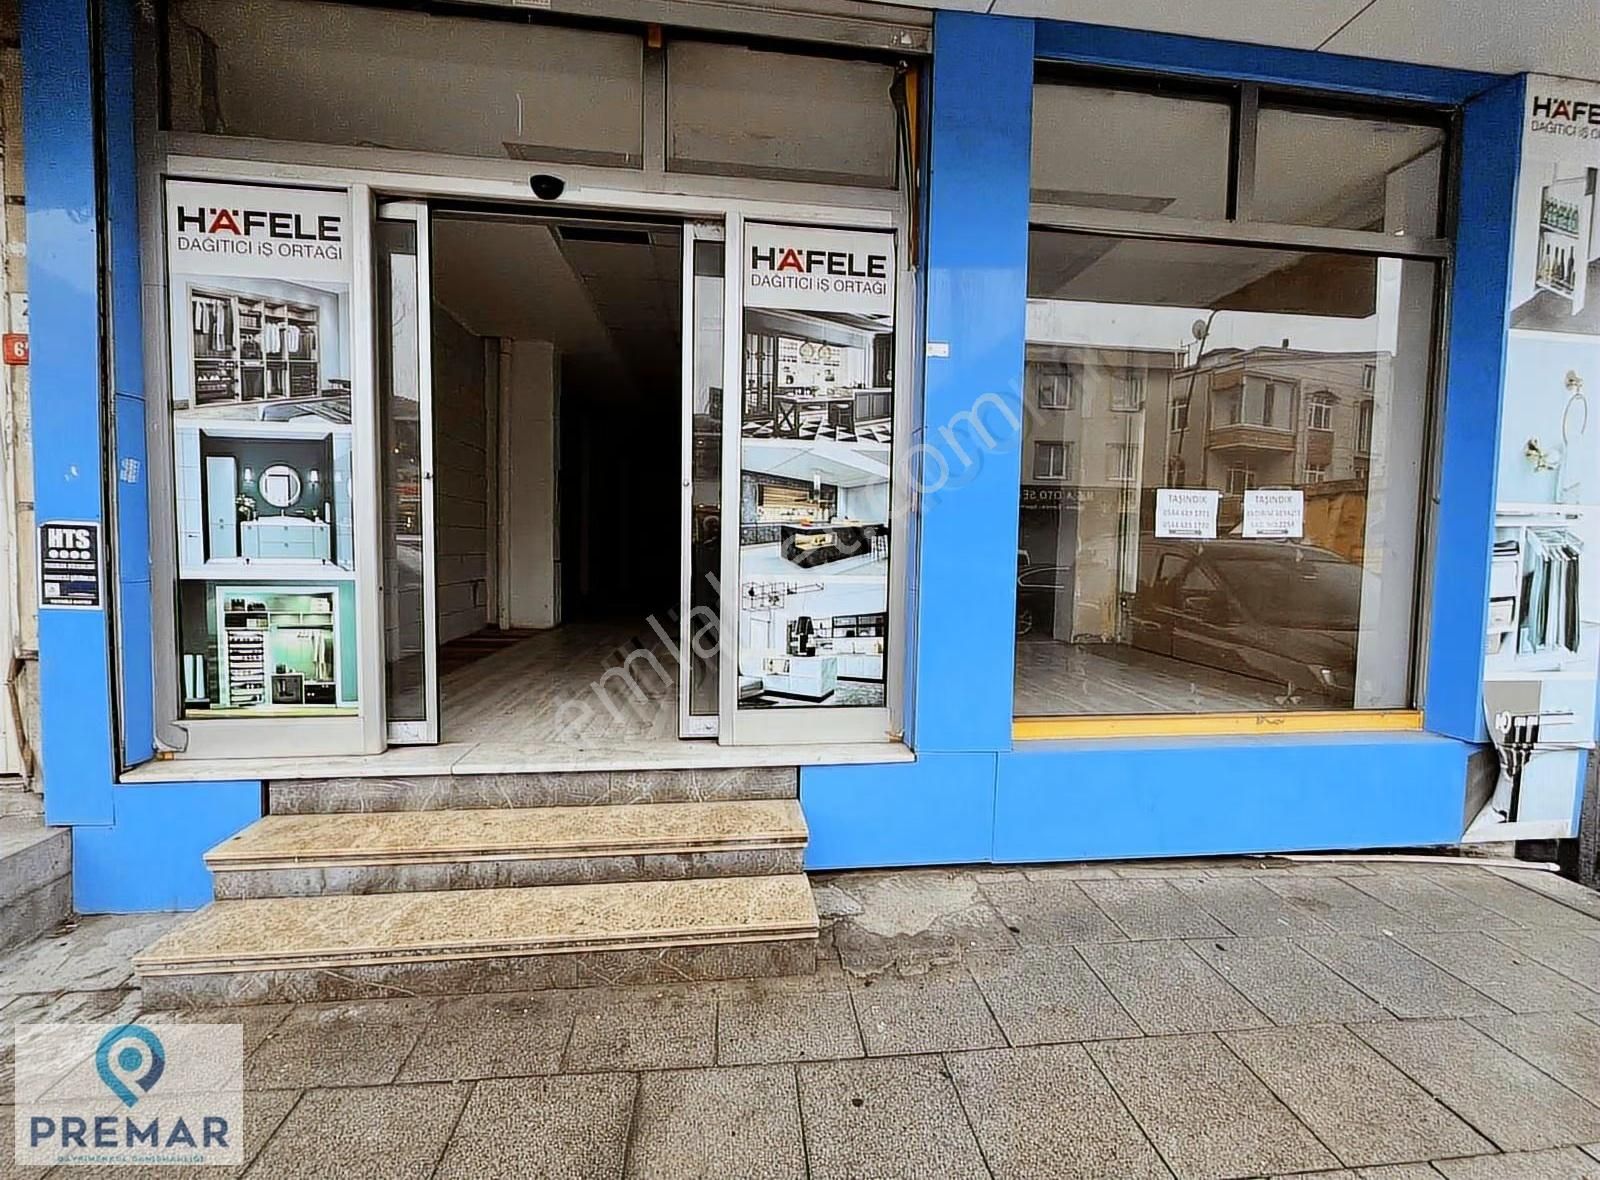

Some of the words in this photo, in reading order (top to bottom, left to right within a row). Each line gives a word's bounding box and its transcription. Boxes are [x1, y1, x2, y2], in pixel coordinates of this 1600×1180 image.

[177, 206, 341, 242] HÄFELE
[751, 246, 887, 278] HÄFELE
[47, 528, 90, 549] HTS
